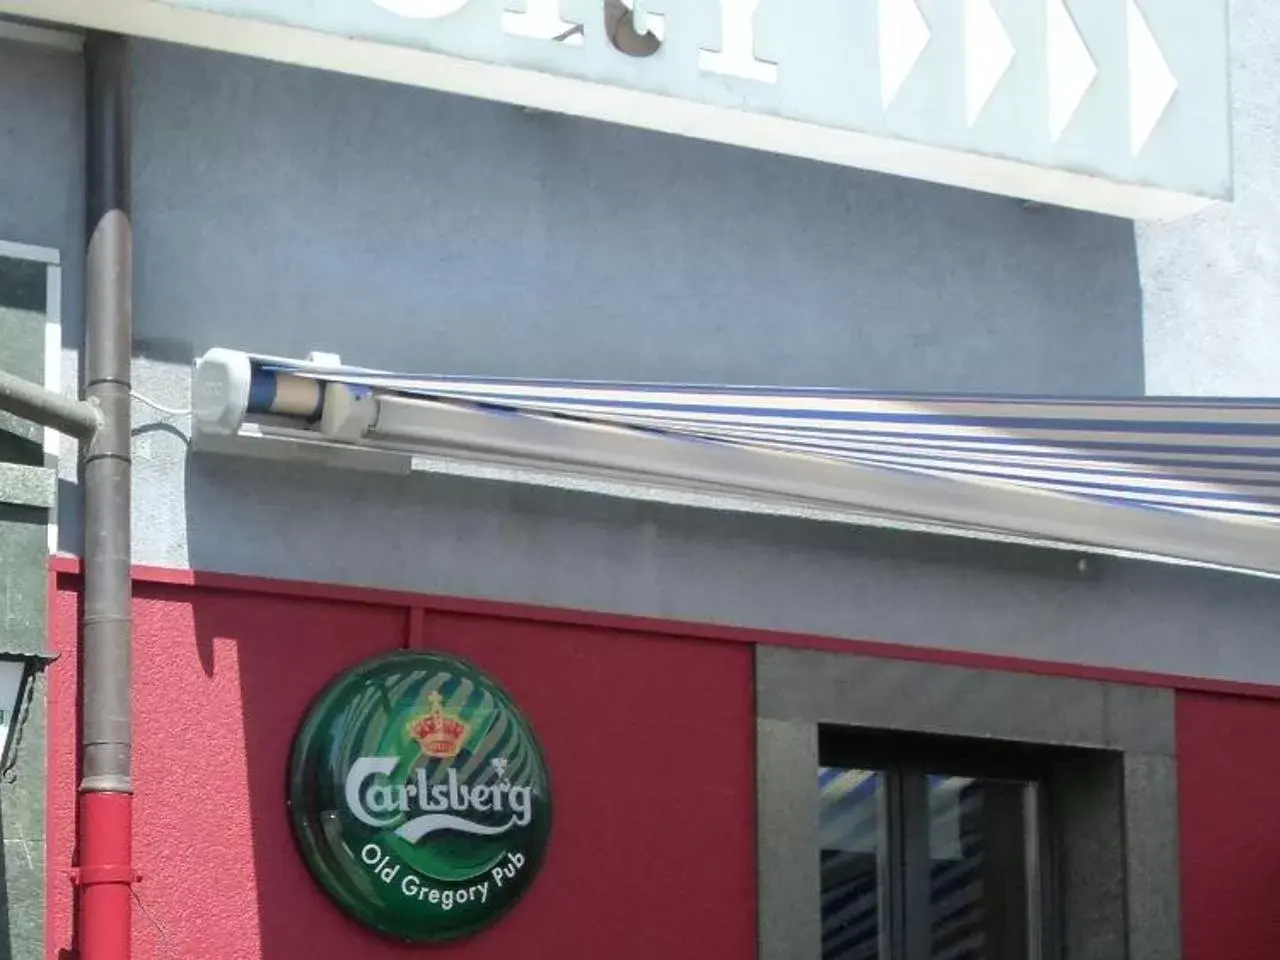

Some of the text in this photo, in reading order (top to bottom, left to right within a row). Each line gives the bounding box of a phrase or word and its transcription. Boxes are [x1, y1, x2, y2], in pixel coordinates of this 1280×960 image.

[345, 757, 534, 844] Carlsberg
[361, 843, 526, 910] Old Gregory Pub
